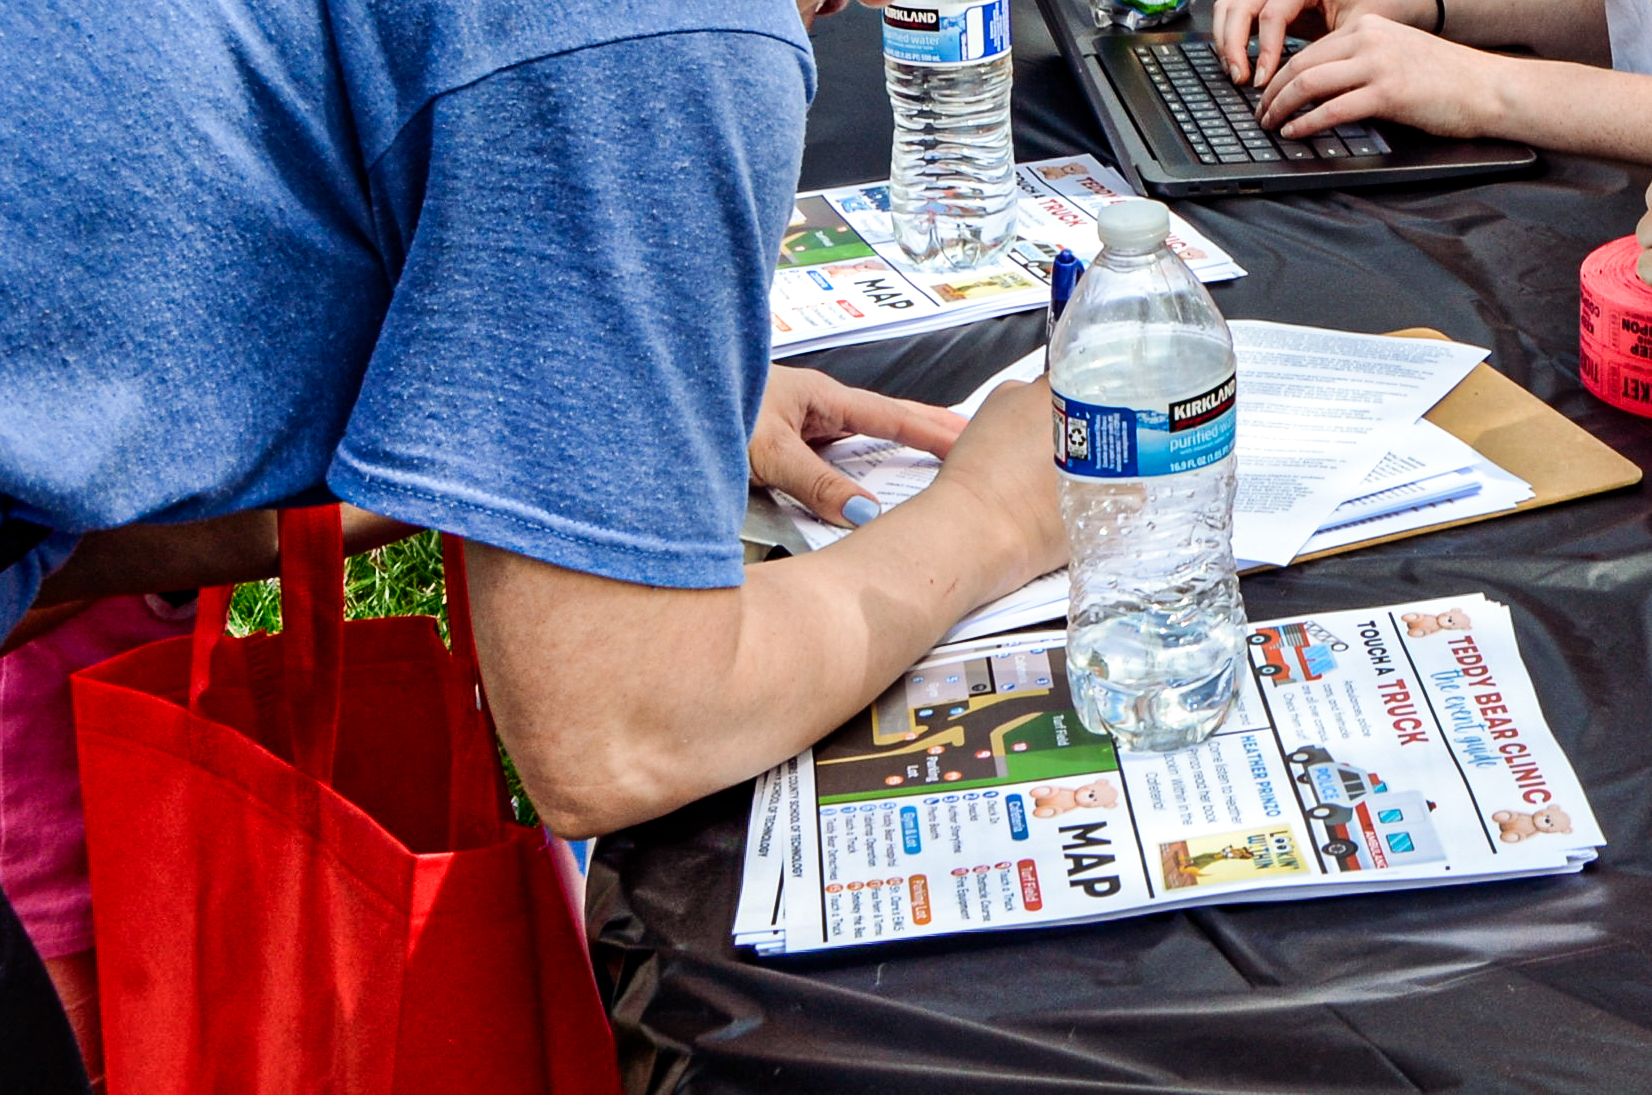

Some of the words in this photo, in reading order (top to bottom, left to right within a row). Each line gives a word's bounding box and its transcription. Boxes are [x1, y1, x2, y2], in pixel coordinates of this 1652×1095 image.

[885, 7, 937, 24] KIRKLAND
[1038, 198, 1088, 227] TRUCK
[854, 277, 915, 310] MAP
[1169, 426, 1219, 453] purified
[1357, 620, 1391, 665] TOUCH
[1375, 667, 1395, 676] A
[1430, 669, 1465, 693] the
[1052, 714, 1065, 729] Turf
[1377, 678, 1430, 746] TRUCK
[1445, 695, 1485, 733] event
[1448, 635, 1497, 687] TEDDY
[1474, 692, 1519, 741] BEAR
[1498, 742, 1552, 805] CLINIC
[1056, 729, 1069, 747] Field
[1208, 742, 1223, 763] Come
[1454, 735, 1503, 769] guide
[907, 765, 920, 779] Lot
[926, 756, 941, 783] Parking
[1193, 769, 1207, 790] read
[1215, 763, 1230, 785] listen
[1241, 734, 1268, 780] HEATHER
[1256, 781, 1281, 818] PRINZO
[768, 781, 781, 806] SCHOOL
[788, 775, 799, 799] COUNTY
[1221, 785, 1233, 794] to
[1316, 767, 1340, 801] POLICE
[1199, 789, 1212, 804] her
[768, 806, 778, 814] OF
[789, 800, 800, 825] SCHOOL
[1181, 813, 1193, 826] the
[1202, 804, 1219, 824] book
[1226, 794, 1243, 825] Heather
[758, 814, 777, 857] TECHNOLOGY
[791, 825, 801, 833] OF
[791, 833, 803, 878] TECHNOLOGY
[1058, 821, 1121, 898] MAP
[1247, 833, 1274, 870] WITHIN
[1021, 866, 1033, 882] Turf
[1004, 893, 1015, 912] Truck
[1023, 881, 1038, 903] Field
